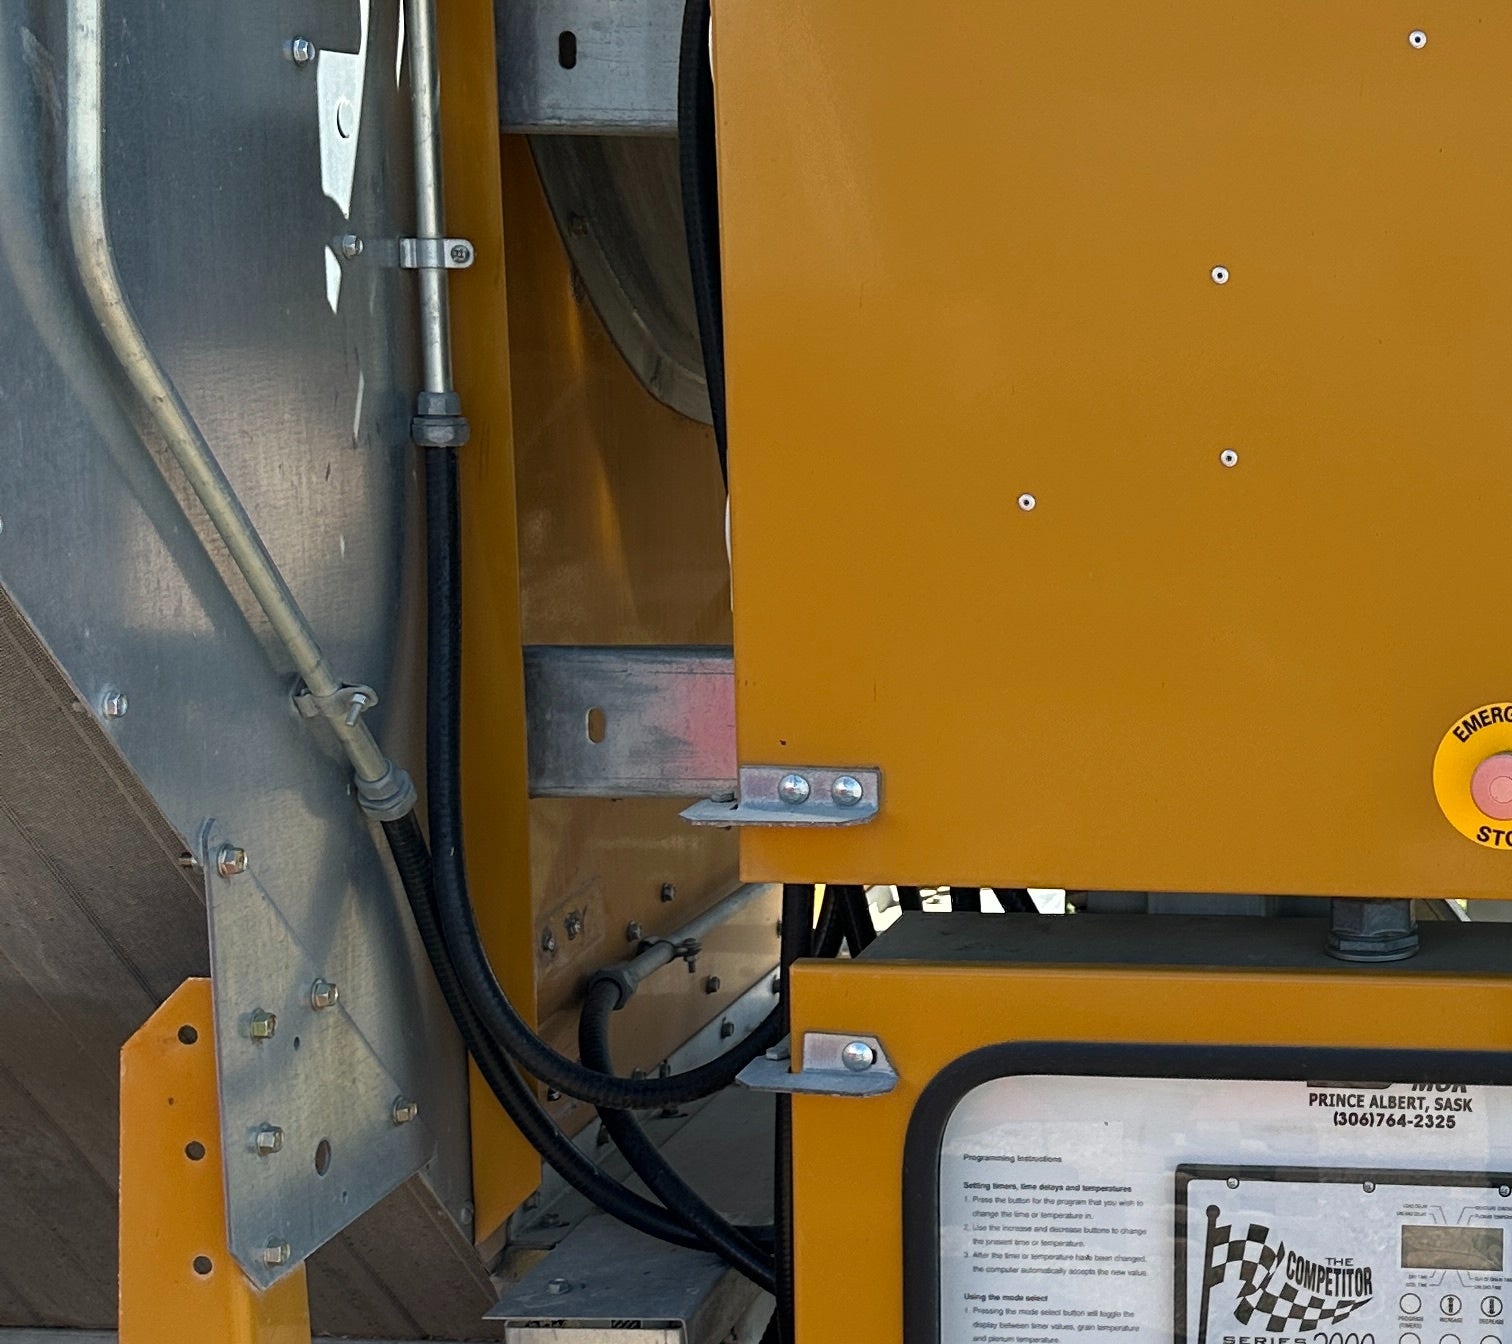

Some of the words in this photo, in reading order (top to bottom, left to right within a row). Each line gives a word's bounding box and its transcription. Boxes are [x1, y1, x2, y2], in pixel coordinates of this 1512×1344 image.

[1308, 1093, 1364, 1108] PRINCE
[1369, 1095, 1430, 1113] ALBERT,
[1434, 1097, 1472, 1112] SASK
[1334, 1111, 1456, 1128] (306)764-2325
[1325, 1257, 1354, 1267] THE
[1286, 1250, 1373, 1297] COMPETITOR
[964, 1293, 986, 1302] Using
